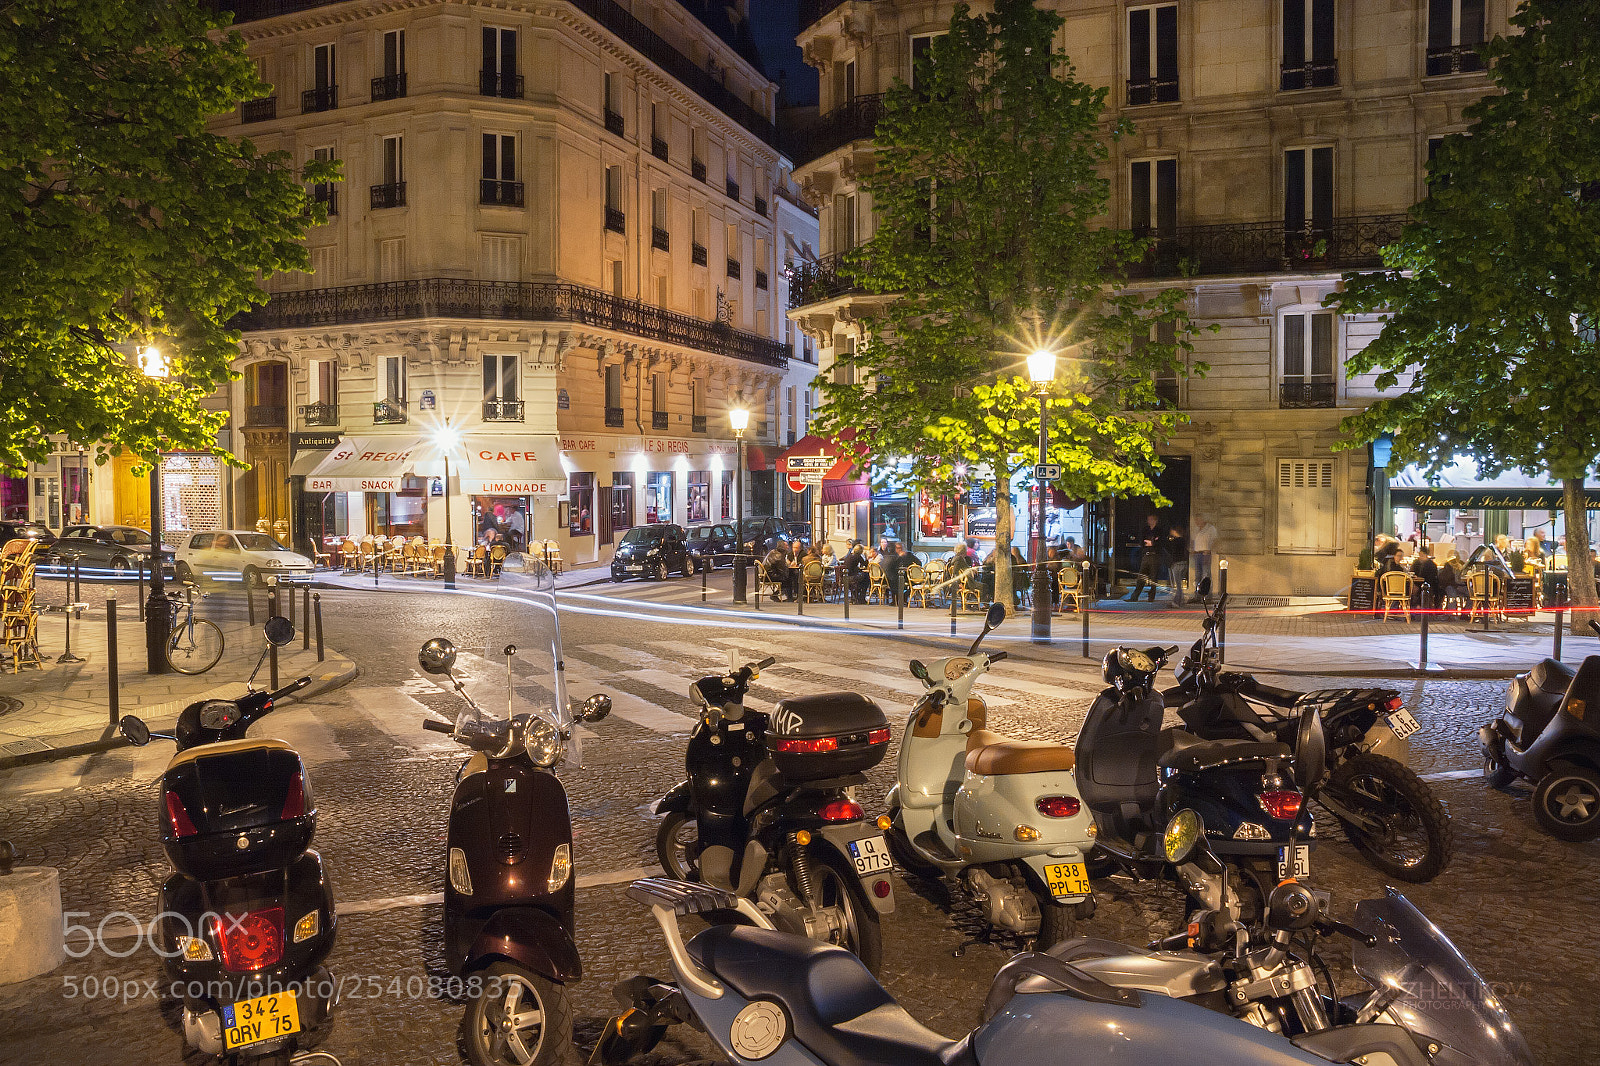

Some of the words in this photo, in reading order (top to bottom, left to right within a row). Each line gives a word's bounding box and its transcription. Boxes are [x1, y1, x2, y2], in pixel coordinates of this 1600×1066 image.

[562, 439, 577, 450] BAR
[578, 440, 596, 450] CAFE
[644, 439, 654, 452] LE
[657, 440, 665, 452] St
[667, 441, 689, 453] REGIS
[333, 451, 354, 461] St
[479, 450, 537, 462] CAFE
[312, 480, 332, 490] BAR
[361, 480, 394, 490] SNACK
[483, 483, 547, 493] LIMONADE
[1414, 495, 1455, 507] Glaces
[1479, 495, 1526, 507] Sorbets
[1531, 496, 1549, 507] de
[1395, 714, 1405, 724] G
[1395, 719, 1419, 738] 640E
[864, 840, 875, 853] Q
[856, 853, 890, 872] 977S
[1053, 864, 1080, 878] 938
[1049, 881, 1075, 895] PPL
[1074, 879, 1090, 893] 75
[242, 997, 279, 1020] 342
[230, 1021, 261, 1044] QRV
[270, 1014, 292, 1034] 75
